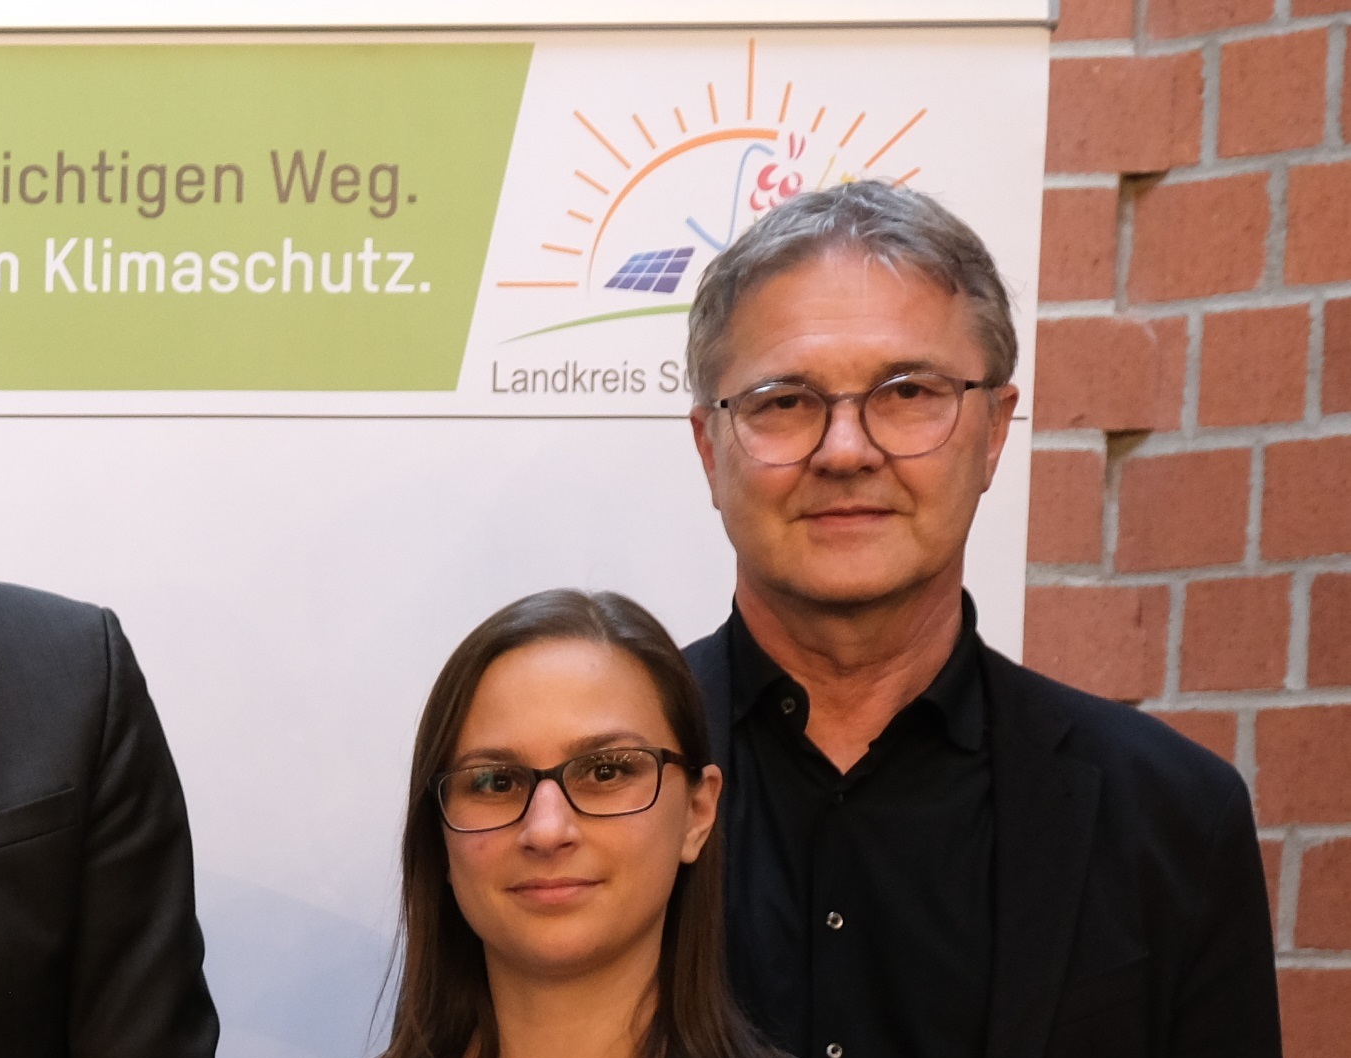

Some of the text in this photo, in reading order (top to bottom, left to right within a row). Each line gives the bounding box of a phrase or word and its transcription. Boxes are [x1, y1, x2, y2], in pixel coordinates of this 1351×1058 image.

[271, 150, 418, 218] Weg.
[45, 238, 431, 294] Klimaschutz.
[492, 361, 646, 394] Landkreis
